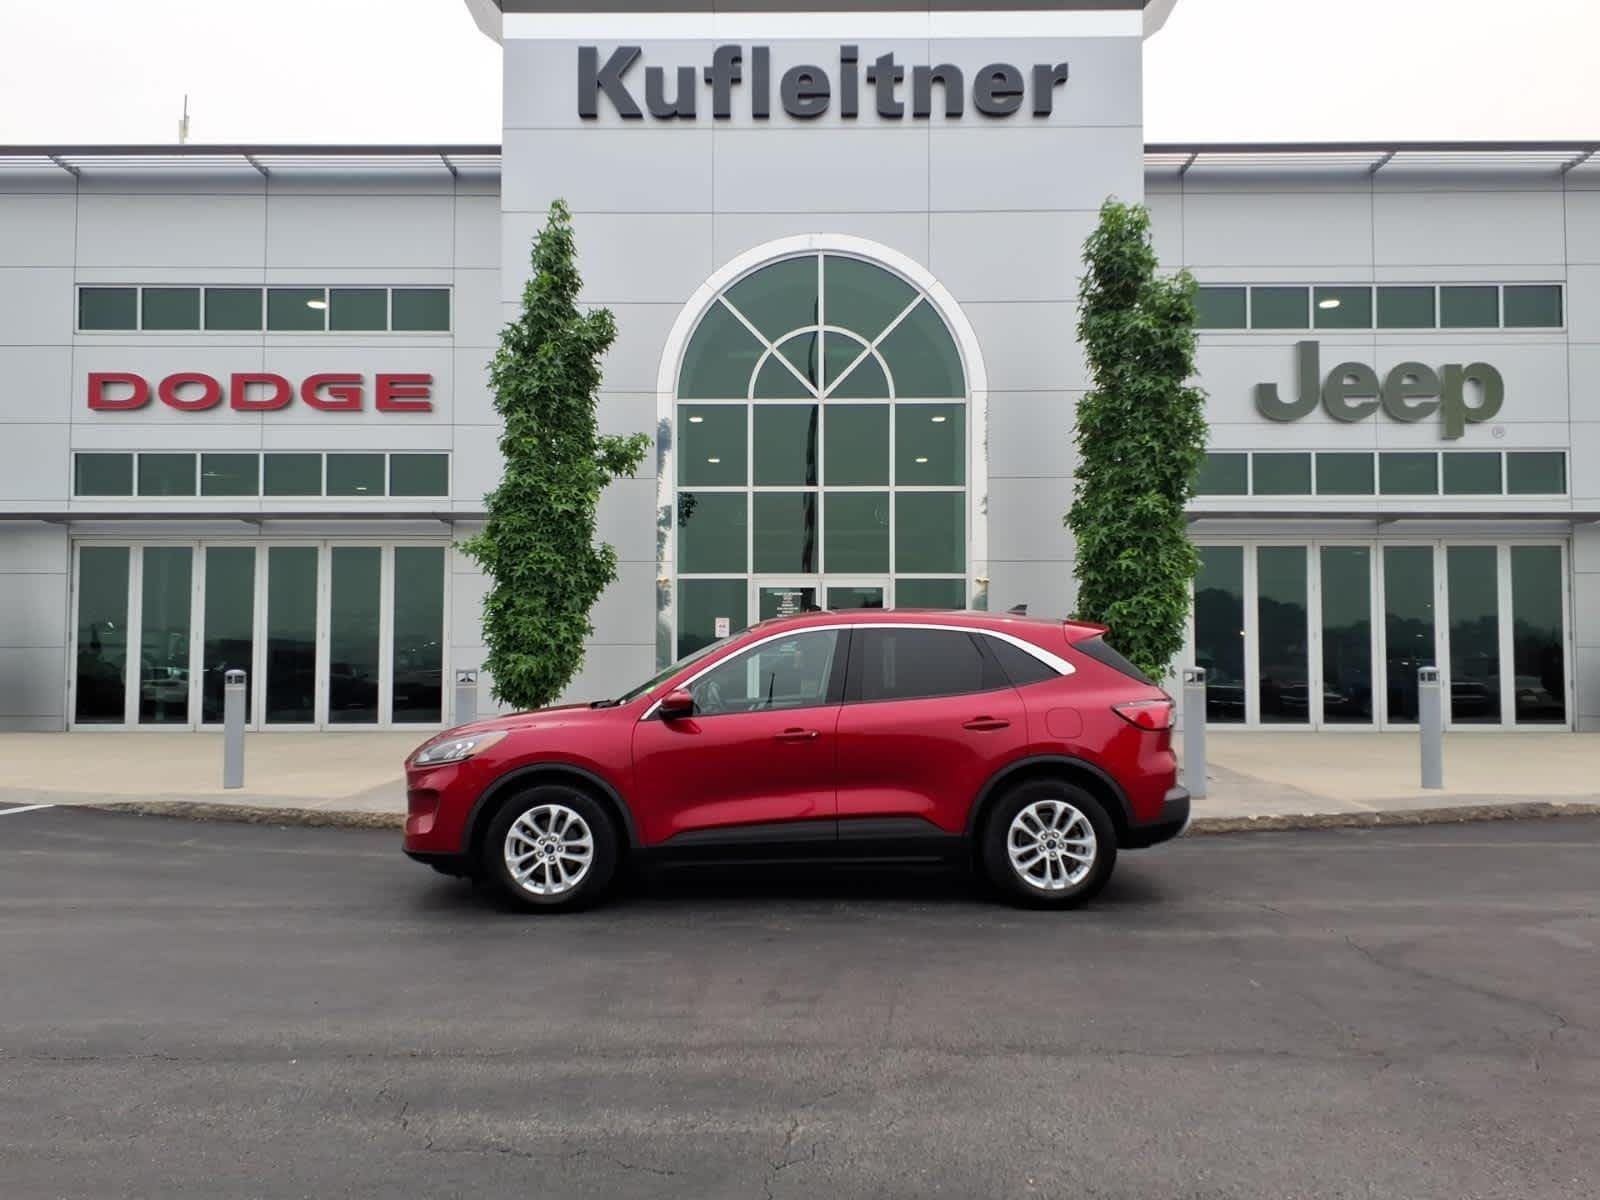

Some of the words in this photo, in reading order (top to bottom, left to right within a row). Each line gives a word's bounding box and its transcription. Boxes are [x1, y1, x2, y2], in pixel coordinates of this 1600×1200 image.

[577, 44, 1069, 120] Kufleitner
[87, 372, 433, 412] DODGE
[1255, 340, 1505, 441] Jeep
